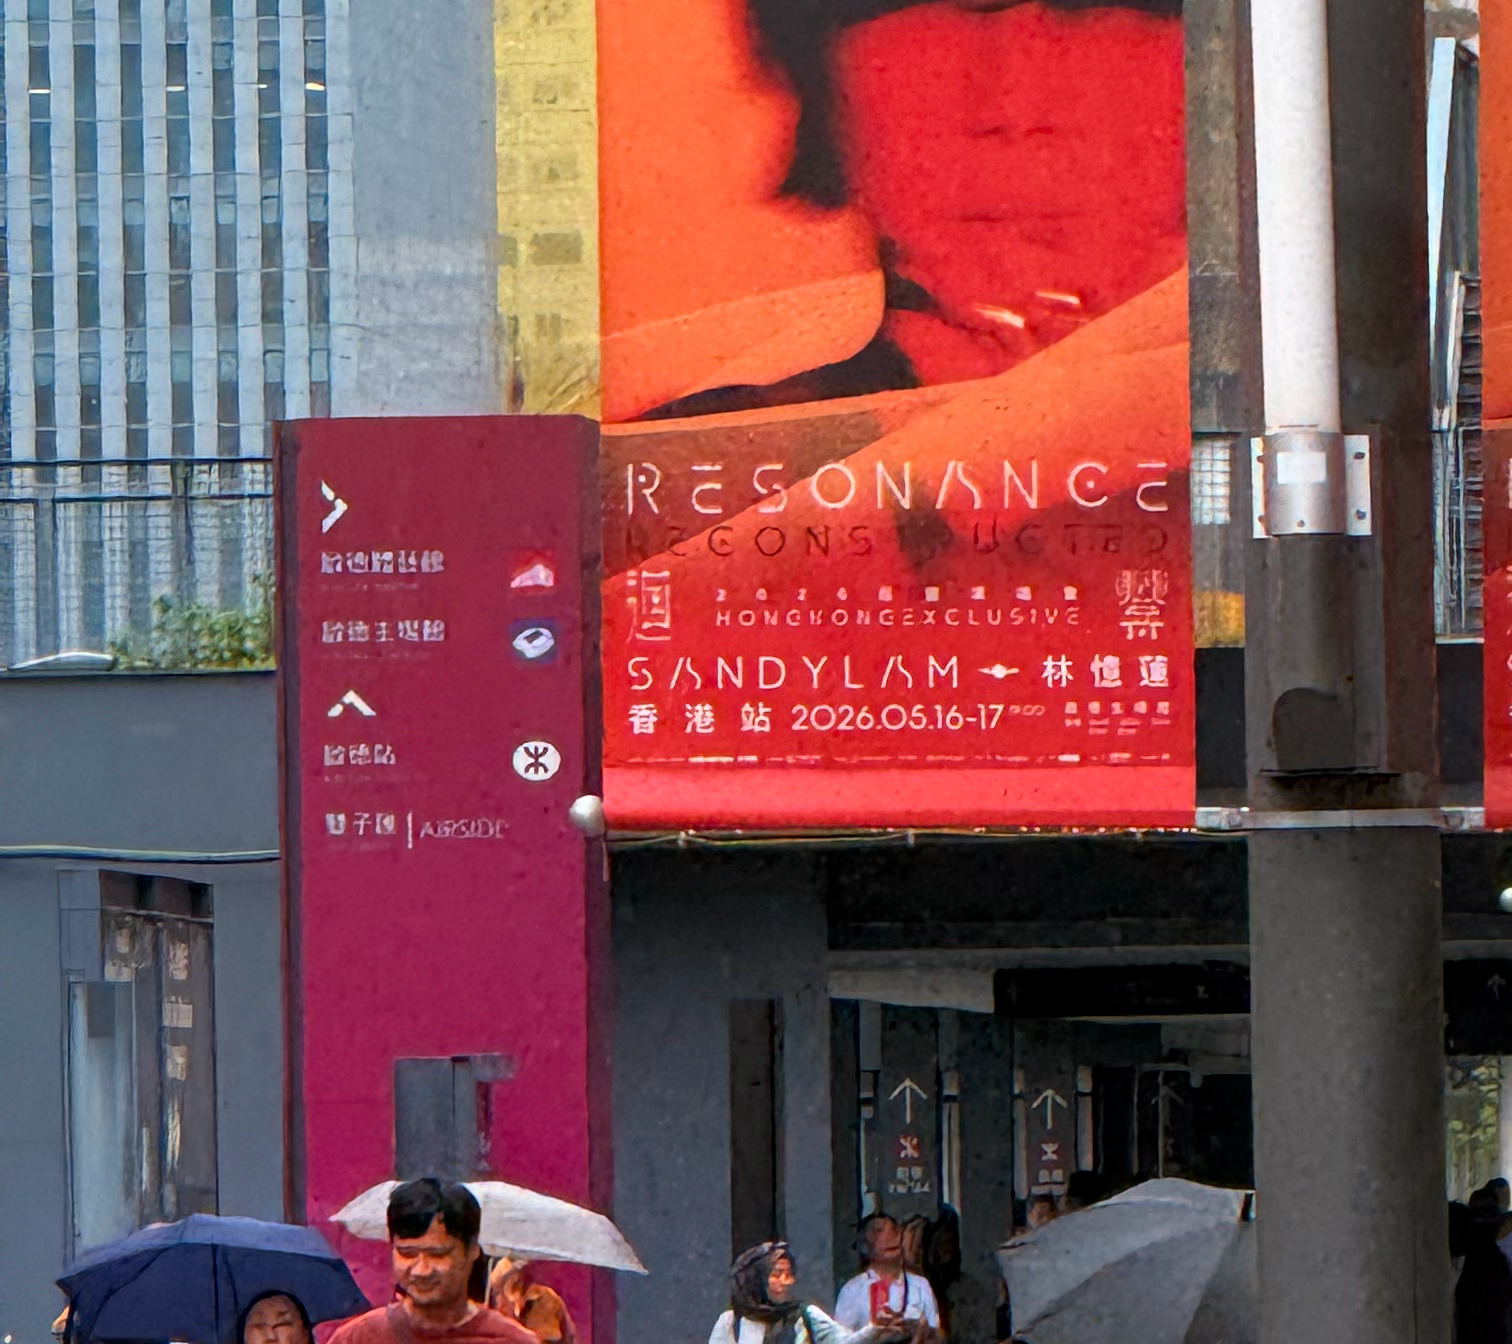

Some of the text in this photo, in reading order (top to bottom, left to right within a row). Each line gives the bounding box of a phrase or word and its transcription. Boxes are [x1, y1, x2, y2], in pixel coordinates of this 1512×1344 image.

[627, 459, 1168, 514] RESONANCE
[628, 701, 772, 734] 香港站
[791, 702, 1004, 733] 2026.05.16-17
